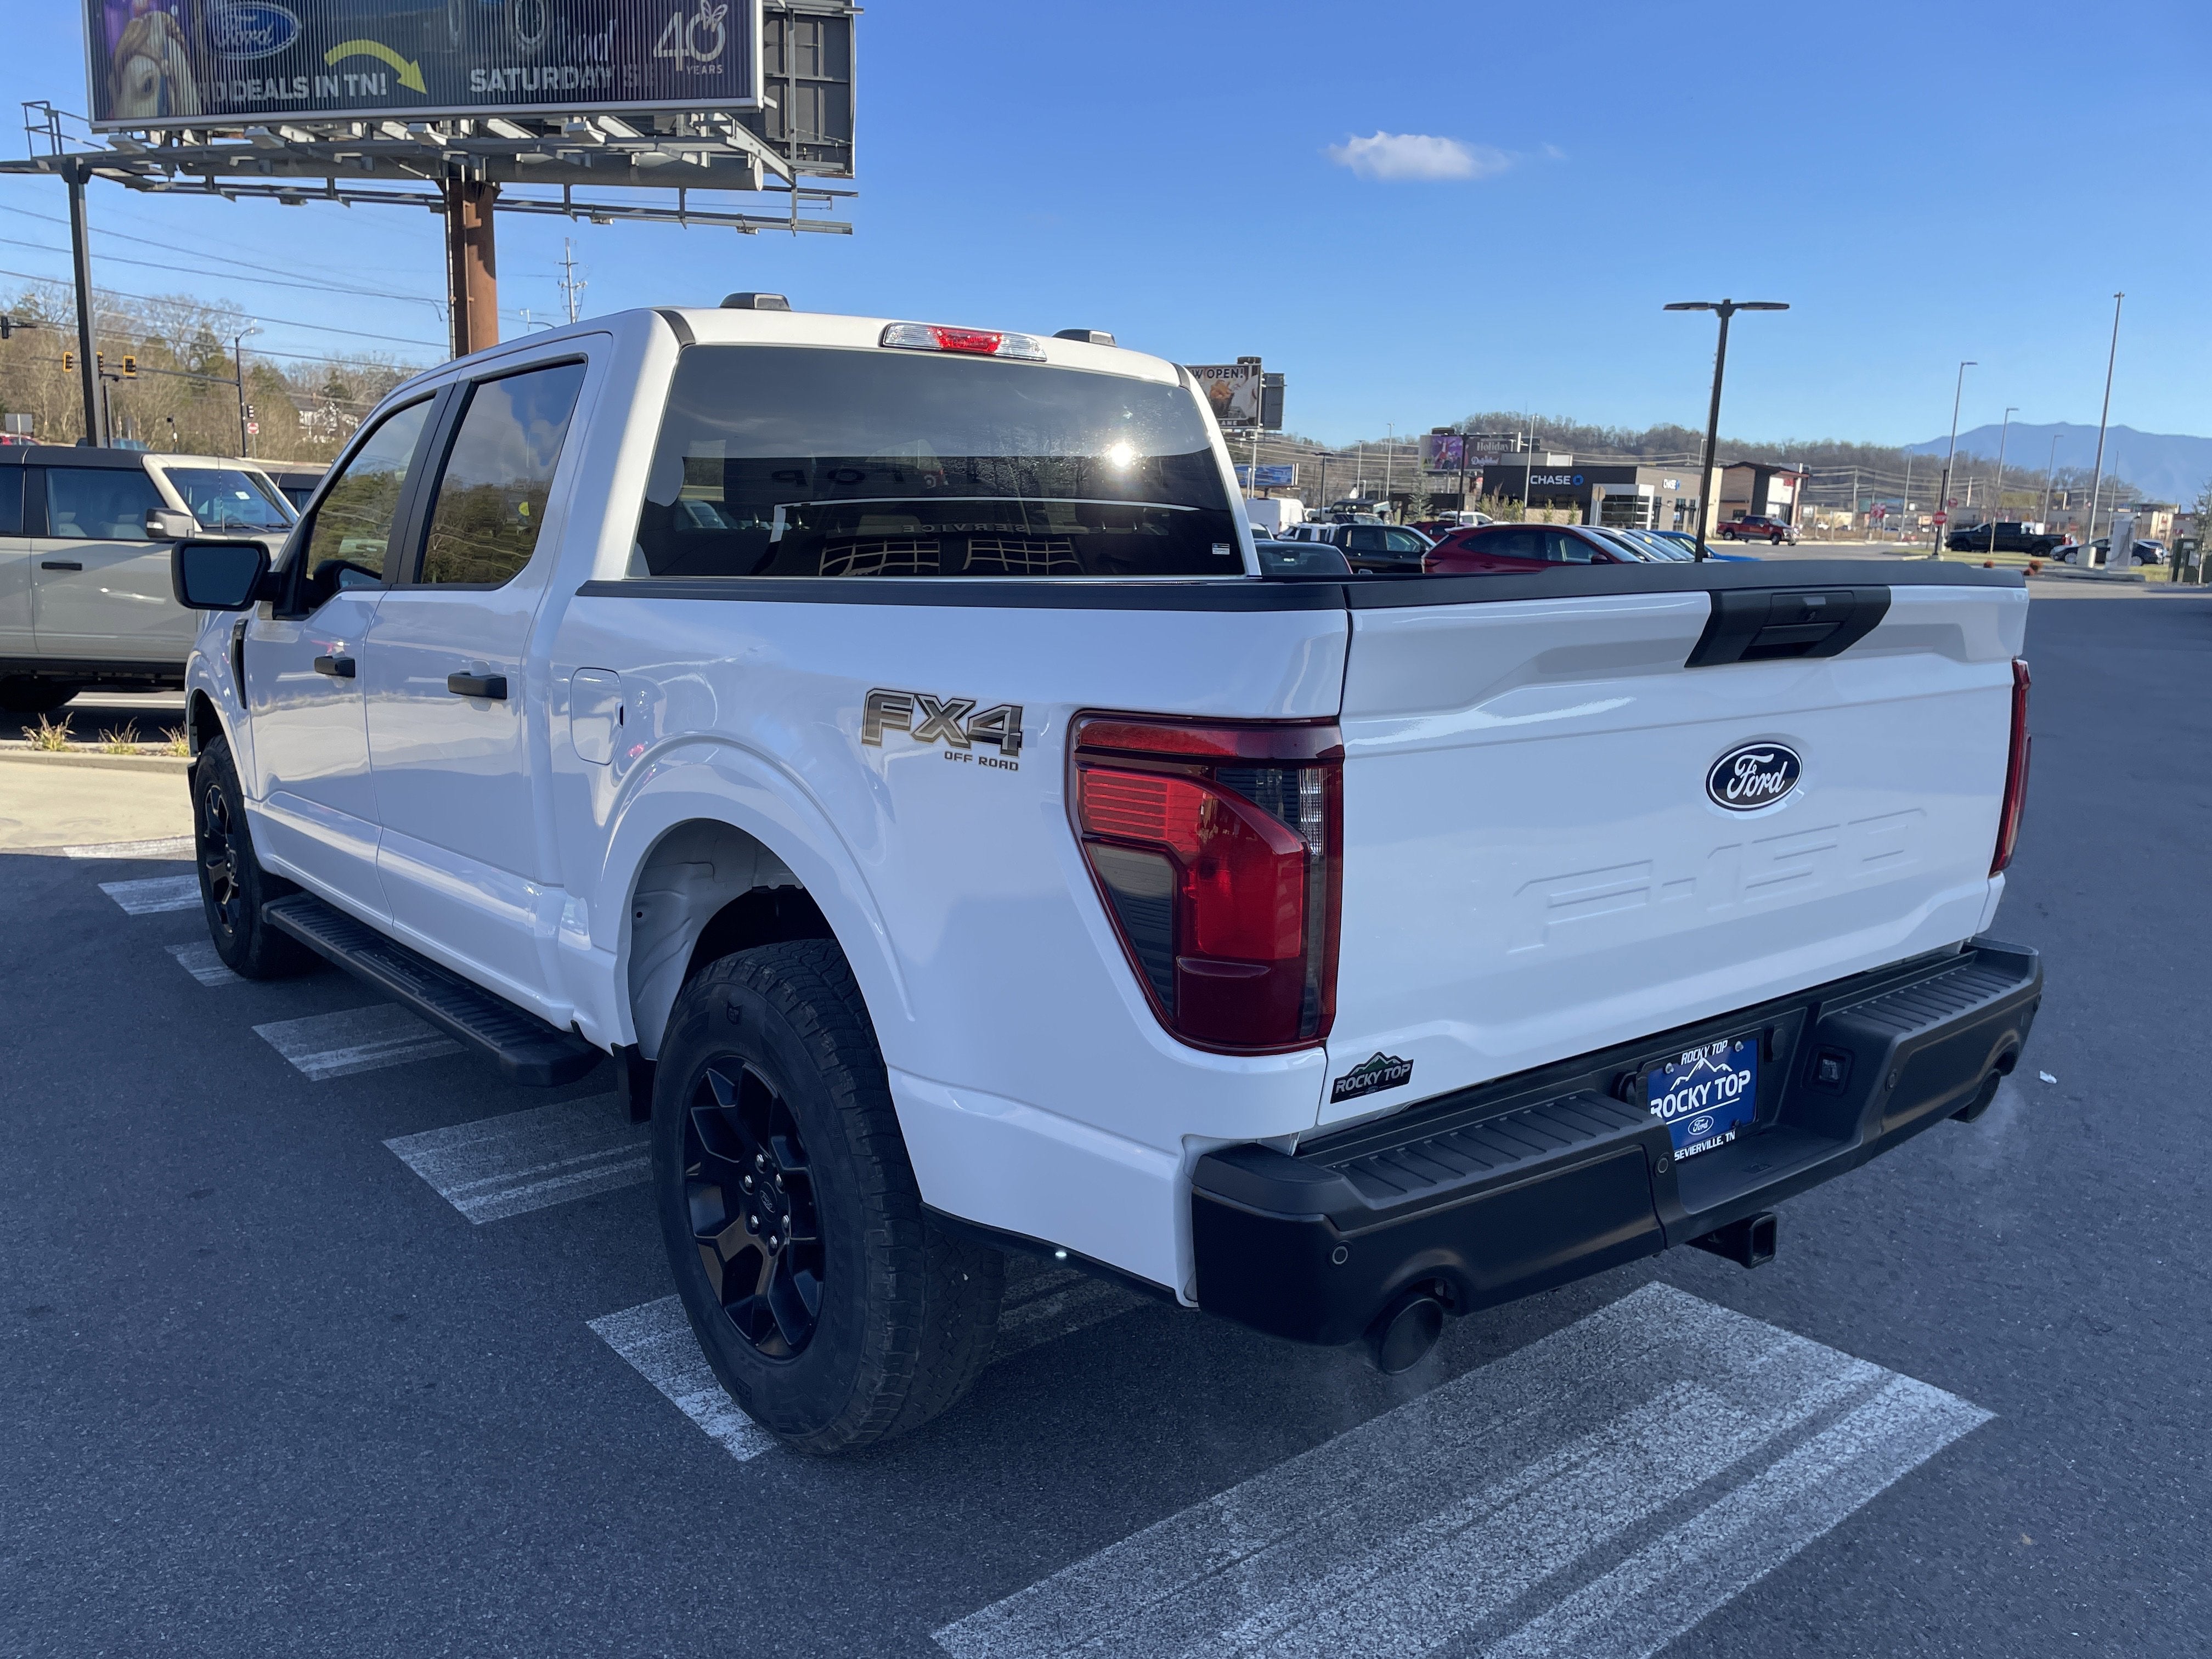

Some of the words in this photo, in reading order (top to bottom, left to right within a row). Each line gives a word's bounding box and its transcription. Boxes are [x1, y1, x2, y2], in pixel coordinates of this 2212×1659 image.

[653, 12, 726, 71] 40
[470, 64, 615, 92] SATURDAY
[686, 64, 723, 75] YEARS
[230, 75, 309, 102] DEALS
[315, 74, 338, 98] IN
[344, 72, 387, 97] TN!
[1207, 368, 1243, 379] OPEN!
[1530, 475, 1571, 485] CHASE
[861, 687, 1024, 758] FX4
[944, 751, 973, 761] OFF
[978, 756, 1019, 771] ROAD
[1726, 753, 1788, 799] Ford
[1680, 1045, 1709, 1065] ROCKY
[1712, 1040, 1728, 1056] TOP
[1335, 1070, 1383, 1094] ROCKY
[1384, 1063, 1411, 1081] TOP
[1650, 1081, 1712, 1118] ROCKY
[1714, 1070, 1751, 1100] TOP
[1692, 1119, 1709, 1132] Ford
[1674, 1136, 1724, 1161] SEVIERVILLE,
[1725, 1130, 1735, 1143] TN
